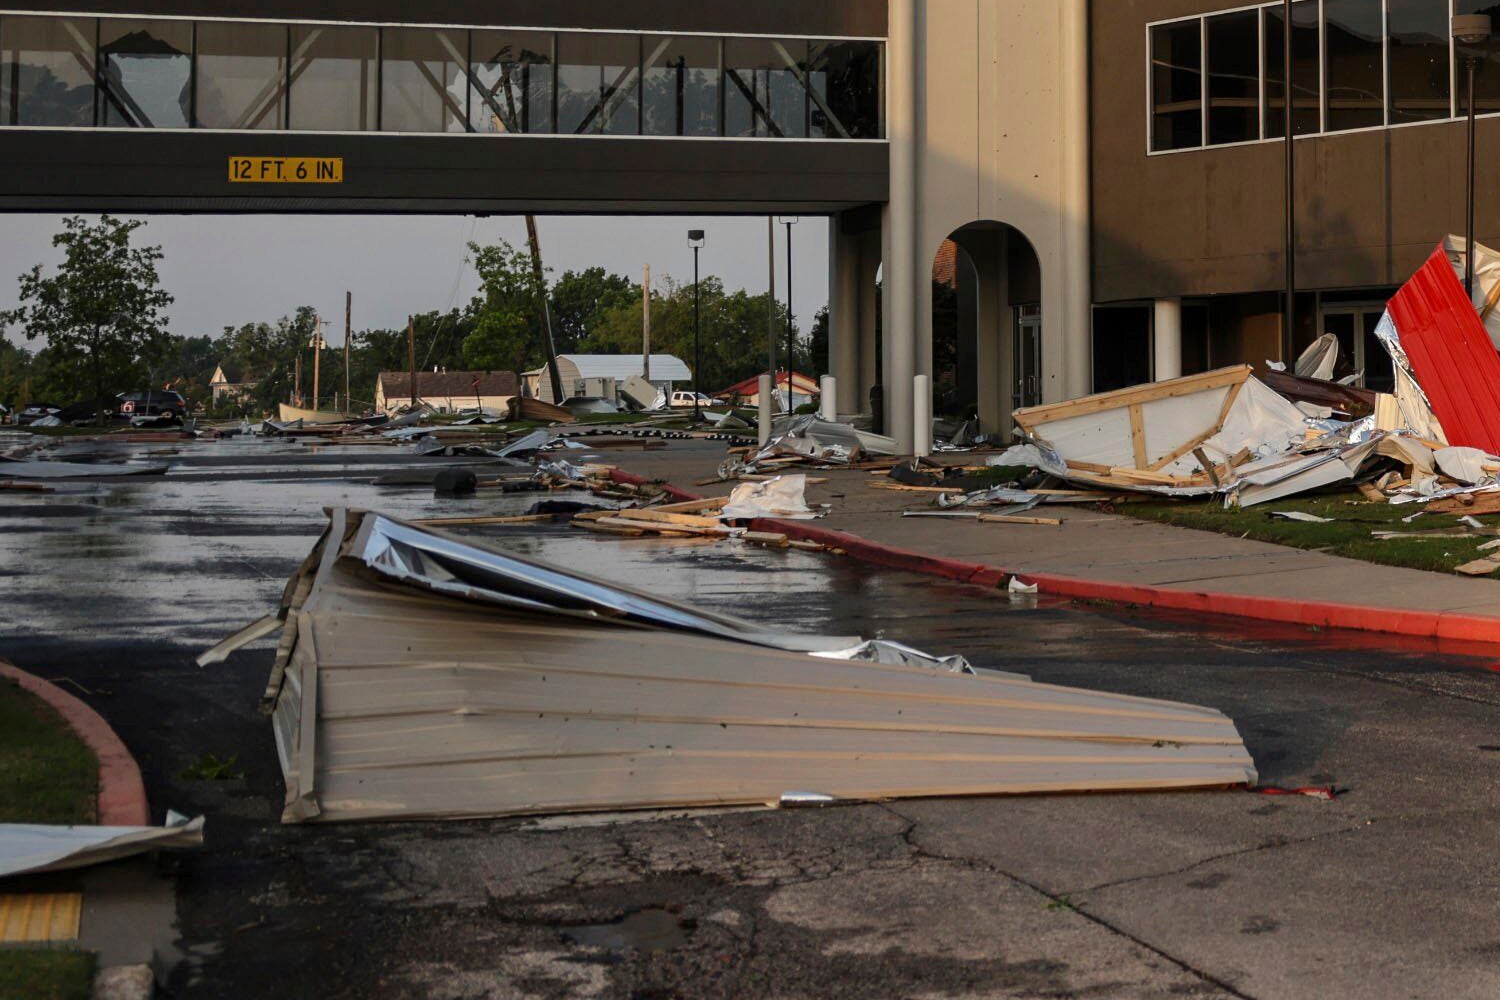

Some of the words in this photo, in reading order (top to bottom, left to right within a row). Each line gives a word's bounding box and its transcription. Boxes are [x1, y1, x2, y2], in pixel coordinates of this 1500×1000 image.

[233, 160, 252, 179] 12
[260, 160, 287, 180] FT.
[296, 161, 308, 179] 6
[316, 161, 339, 180] IN.
